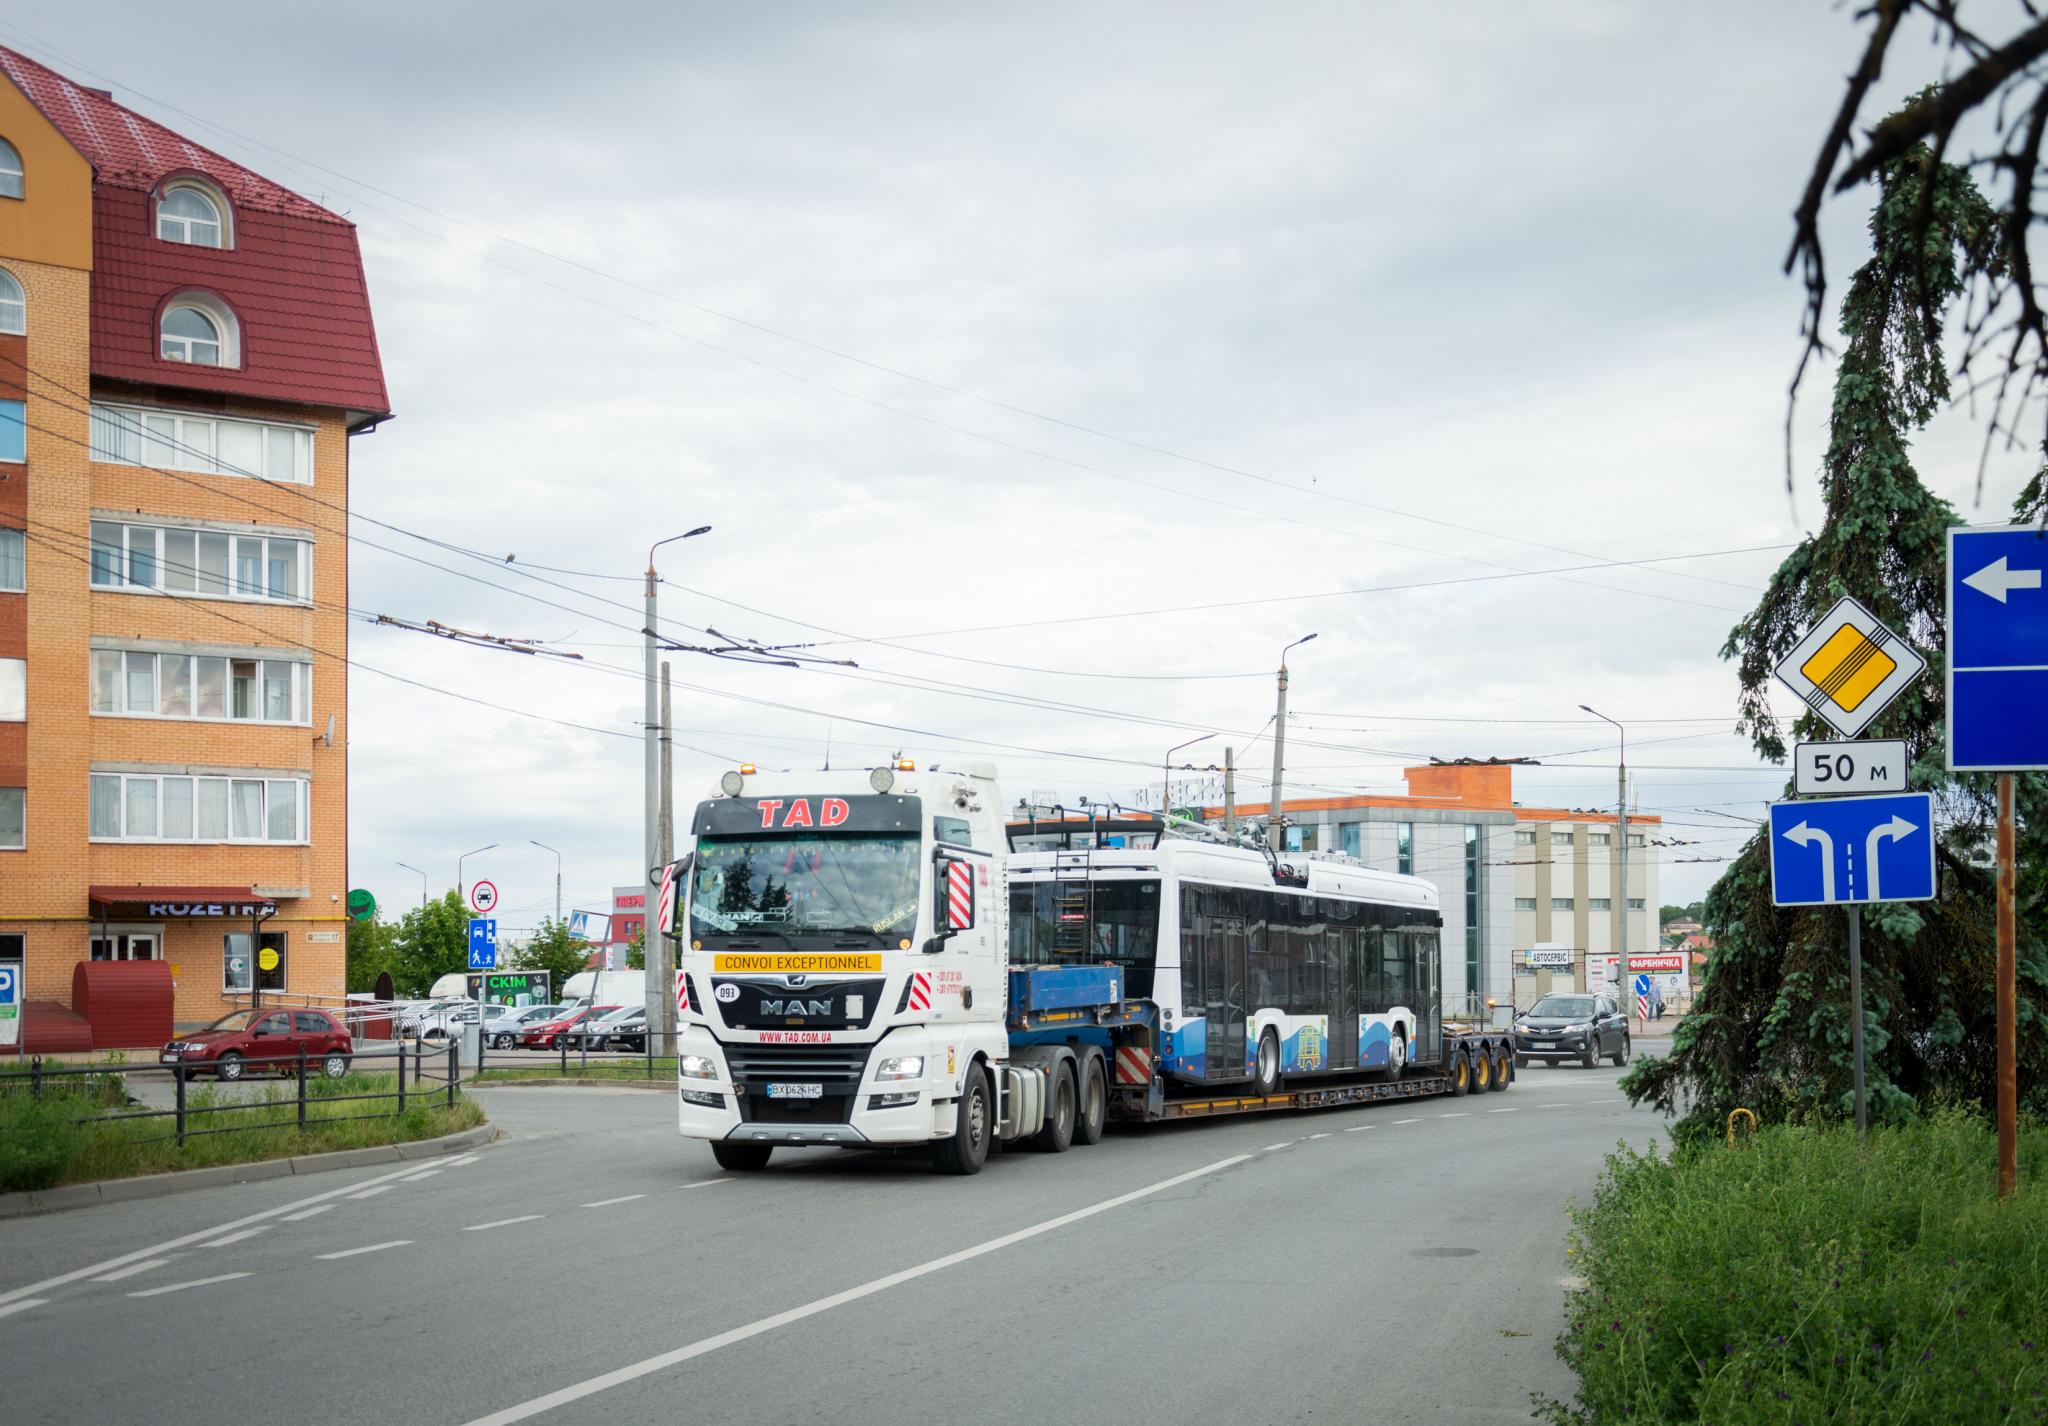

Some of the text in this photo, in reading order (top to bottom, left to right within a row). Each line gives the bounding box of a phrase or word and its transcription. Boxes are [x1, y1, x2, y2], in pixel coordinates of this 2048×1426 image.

[1814, 754, 1855, 782] 50
[757, 798, 850, 828] TAD
[725, 956, 872, 969] CONVOI EXCEPTIONNEL
[1533, 952, 1567, 962] АВТОСЕРВІС
[760, 1000, 832, 1016] MAN
[759, 1032, 832, 1043] WWW.TAD.COM.UA
